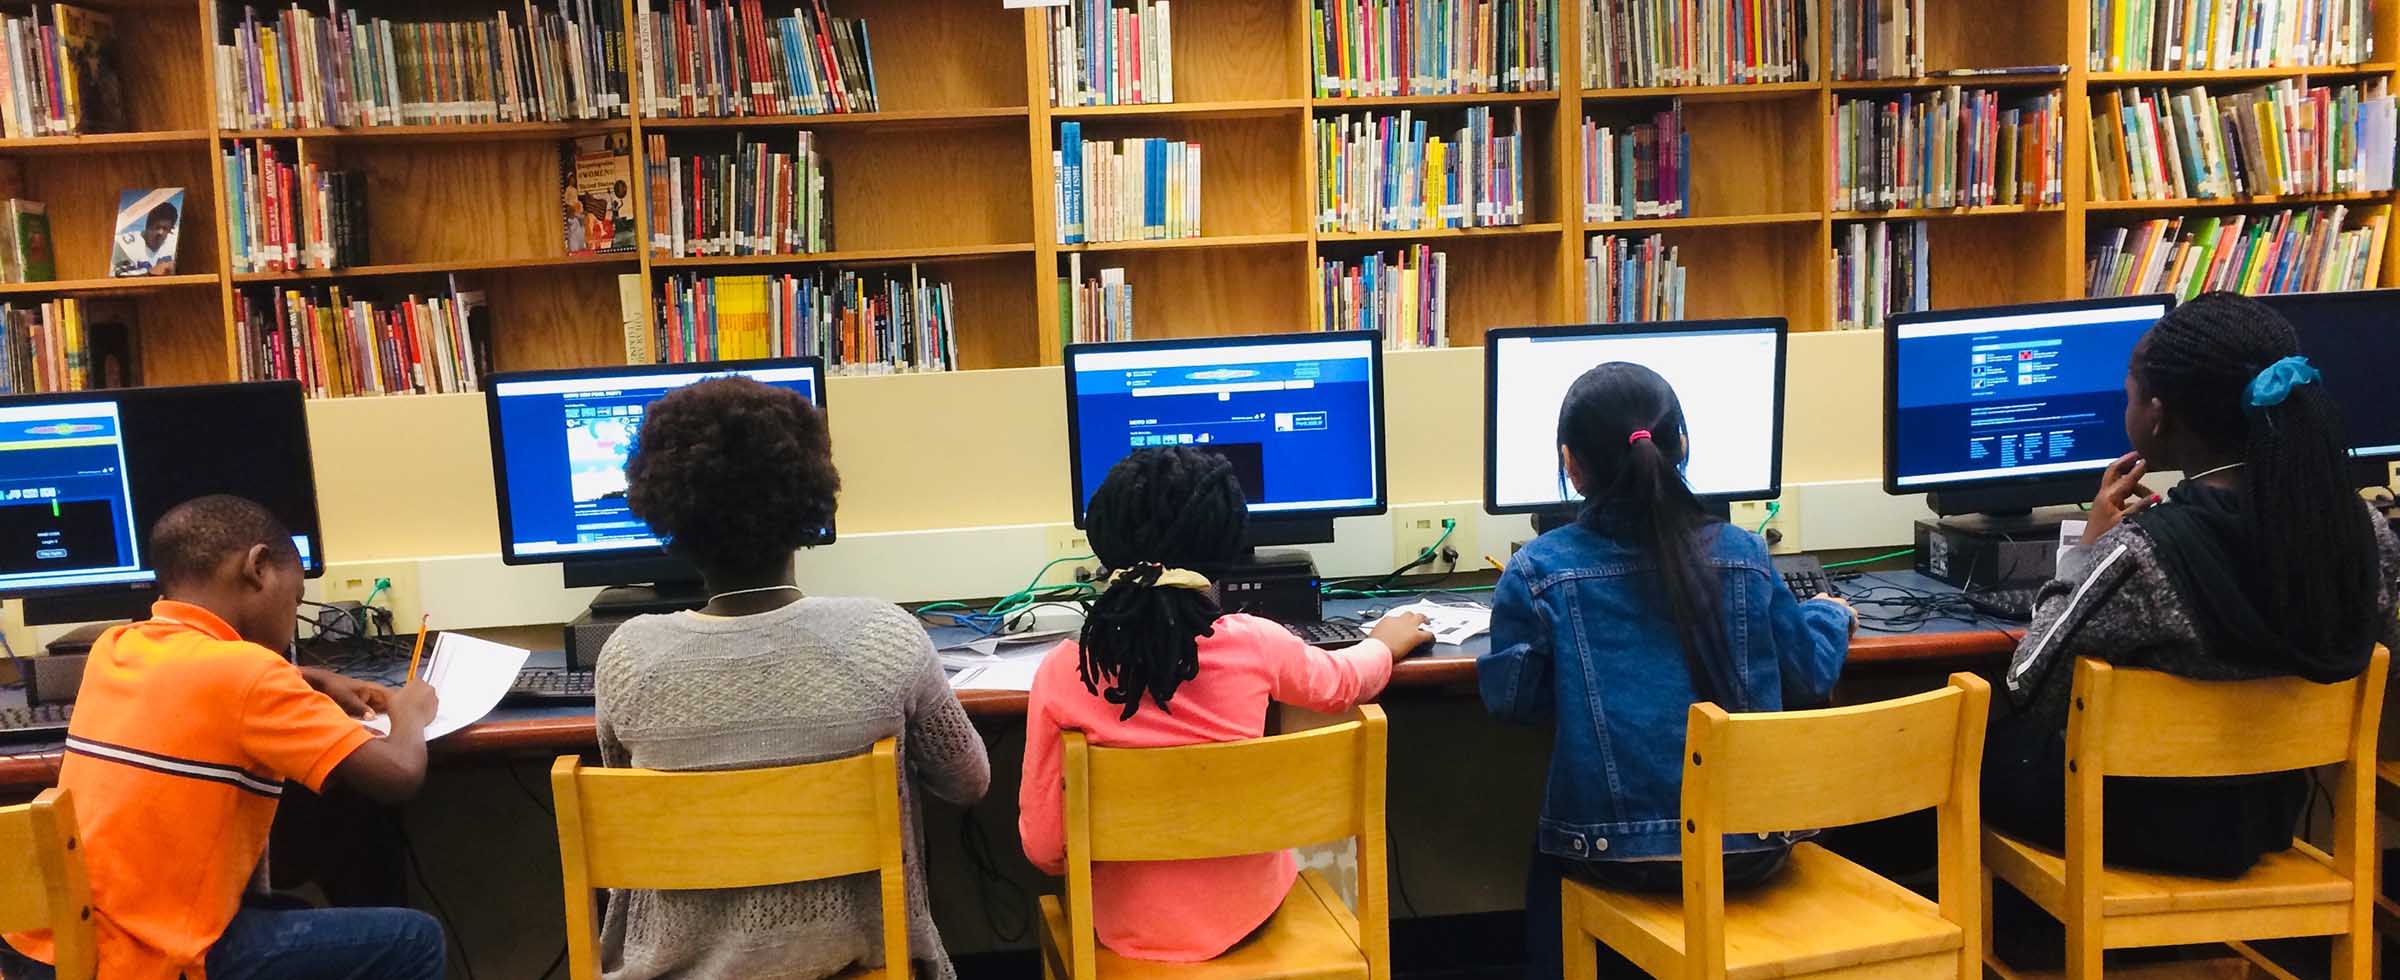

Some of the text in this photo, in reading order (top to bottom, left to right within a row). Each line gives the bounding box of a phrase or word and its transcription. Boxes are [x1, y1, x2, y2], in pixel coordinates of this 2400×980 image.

[264, 158, 275, 198] SLAVERY
[289, 312, 297, 326] We
[290, 327, 300, 347] Shall
